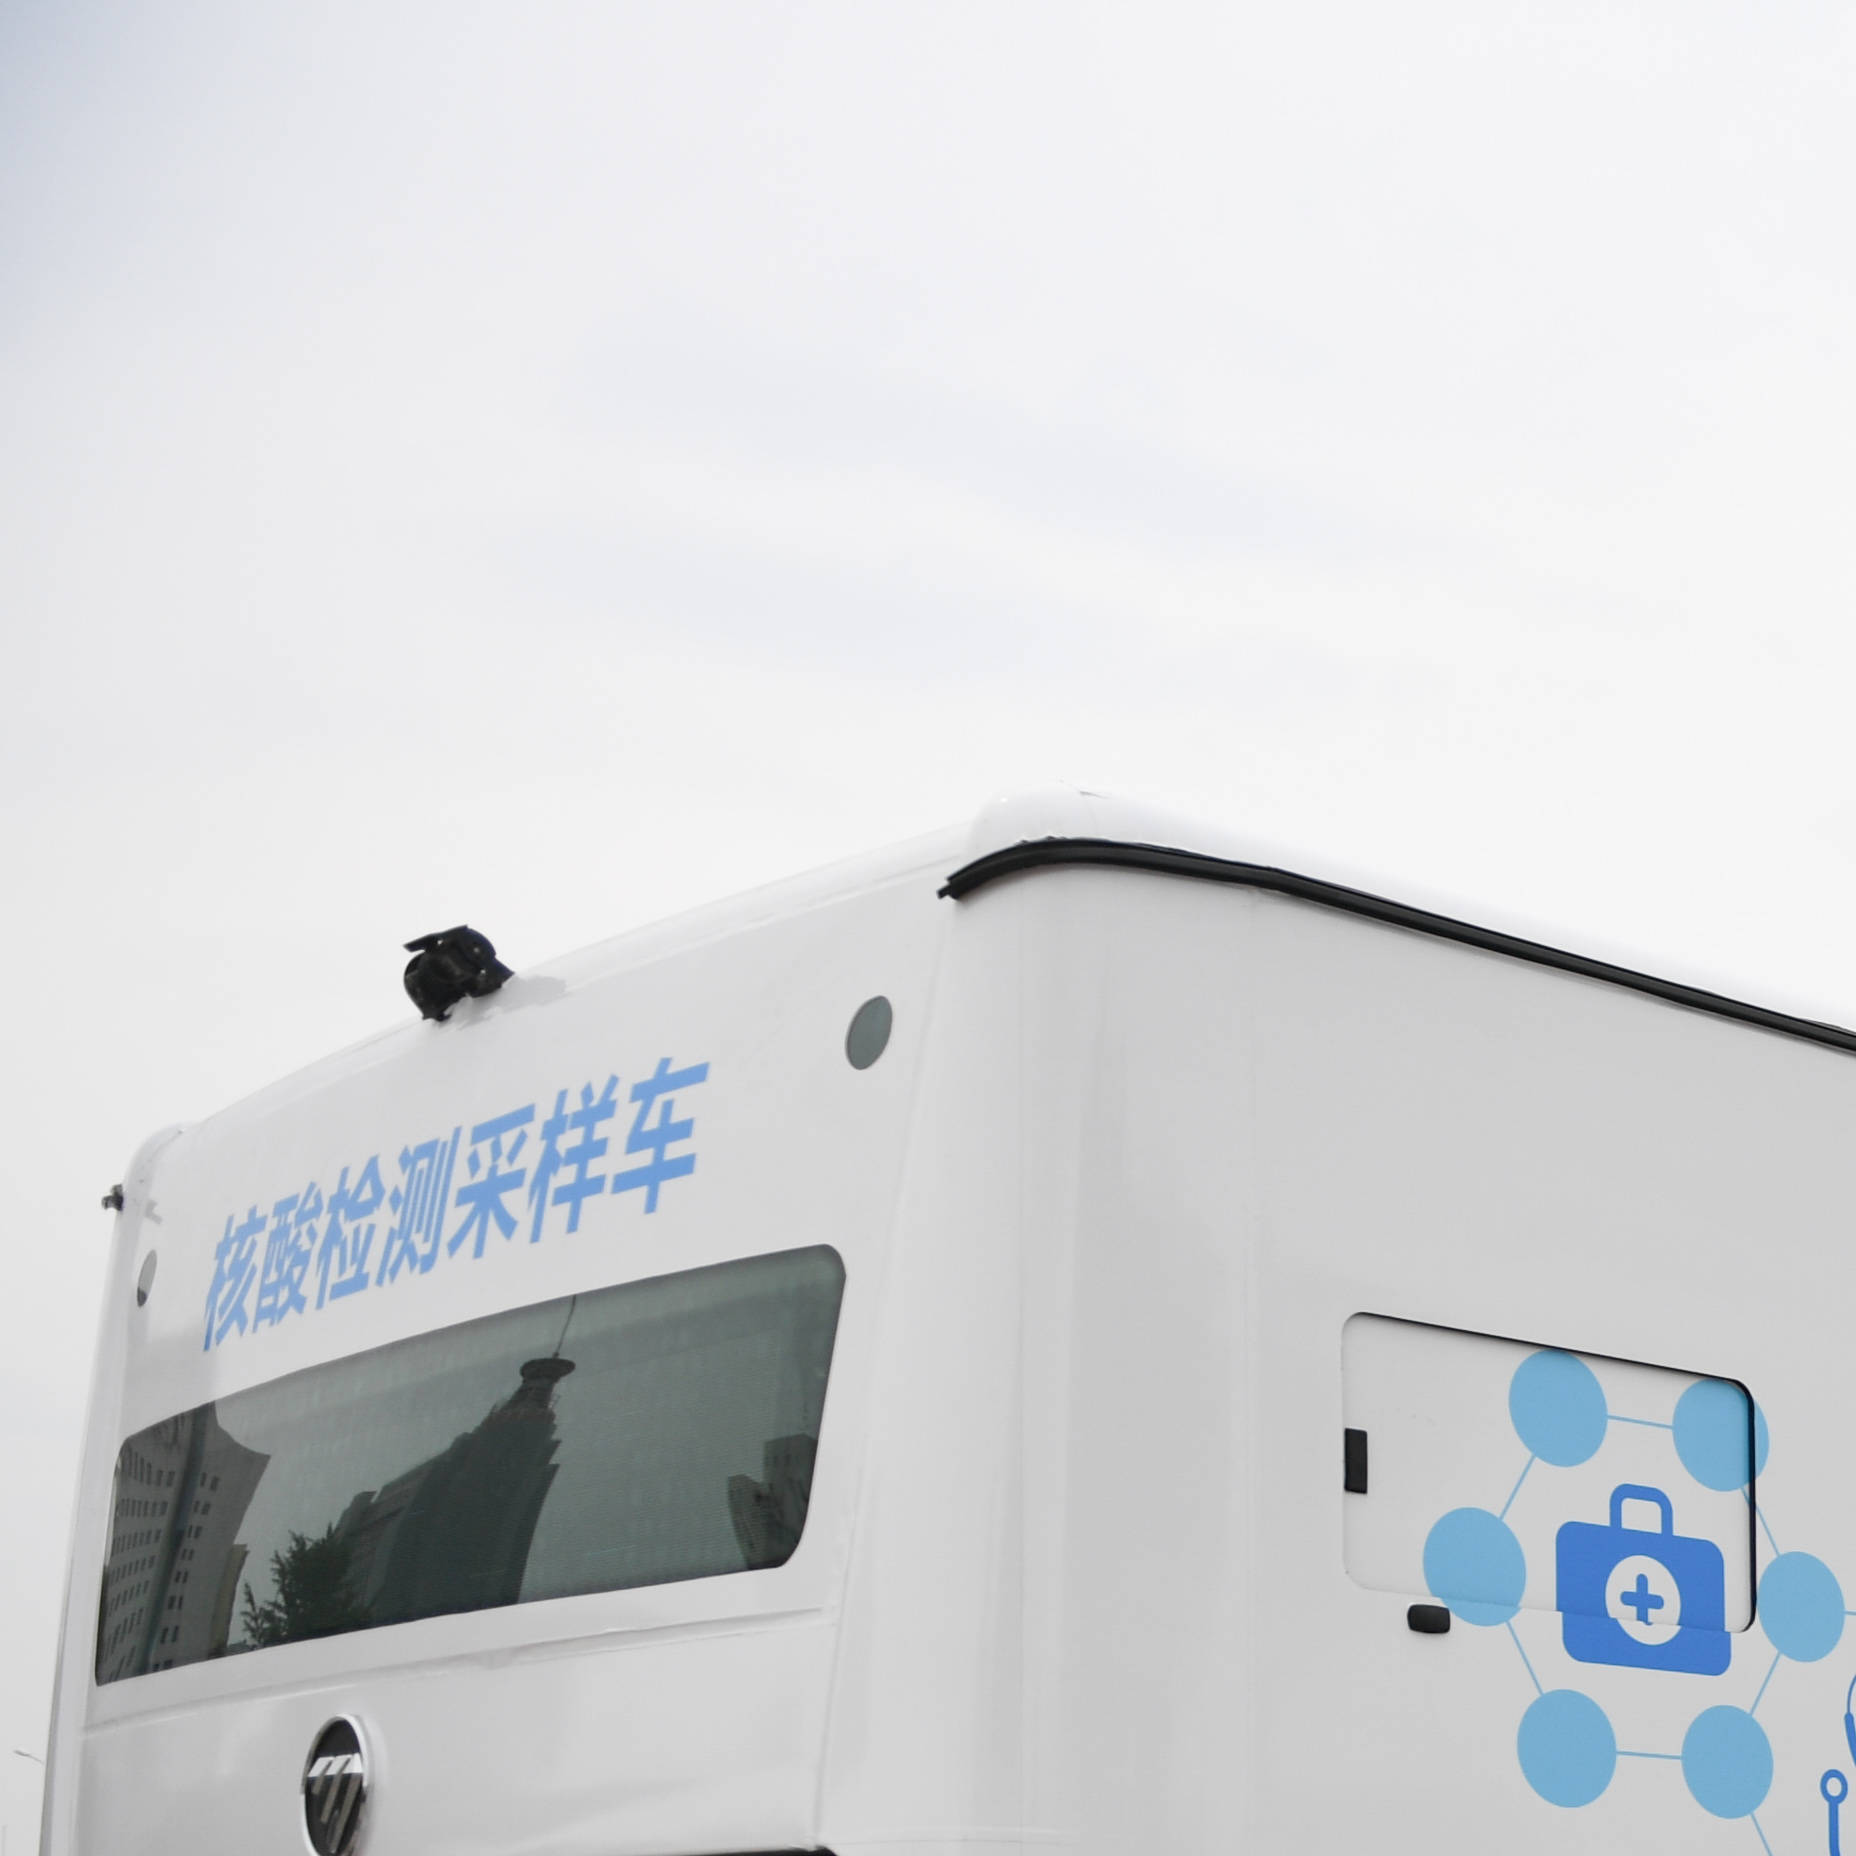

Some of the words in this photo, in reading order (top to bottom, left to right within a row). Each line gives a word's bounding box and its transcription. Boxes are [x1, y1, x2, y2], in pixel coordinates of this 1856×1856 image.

[203, 1056, 710, 1352] 核酸检测采样车
